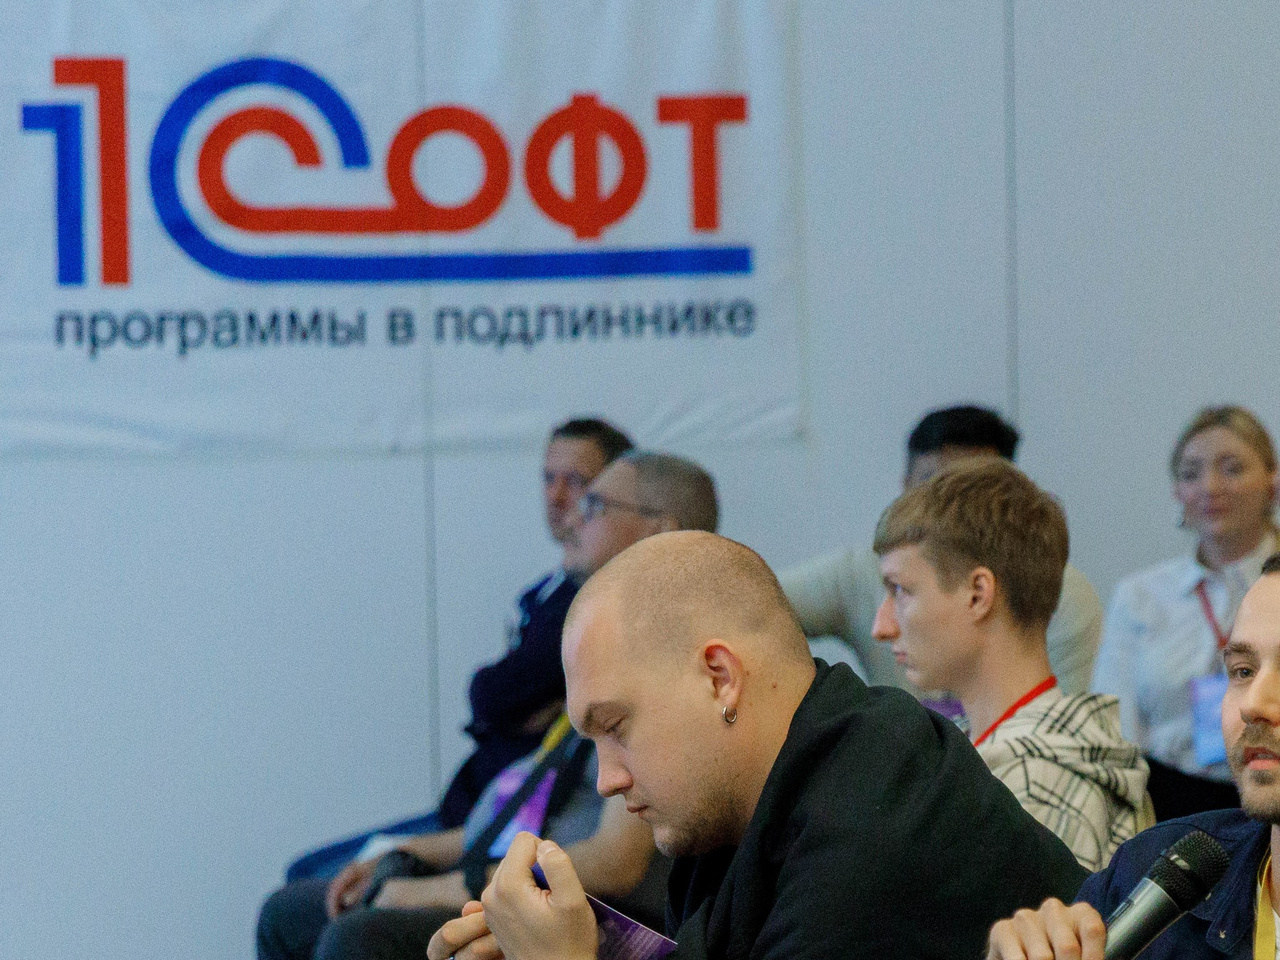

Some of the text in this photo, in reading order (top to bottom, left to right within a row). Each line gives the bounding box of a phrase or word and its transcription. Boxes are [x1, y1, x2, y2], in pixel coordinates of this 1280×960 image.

[54, 298, 757, 359] программы в подлиннике
